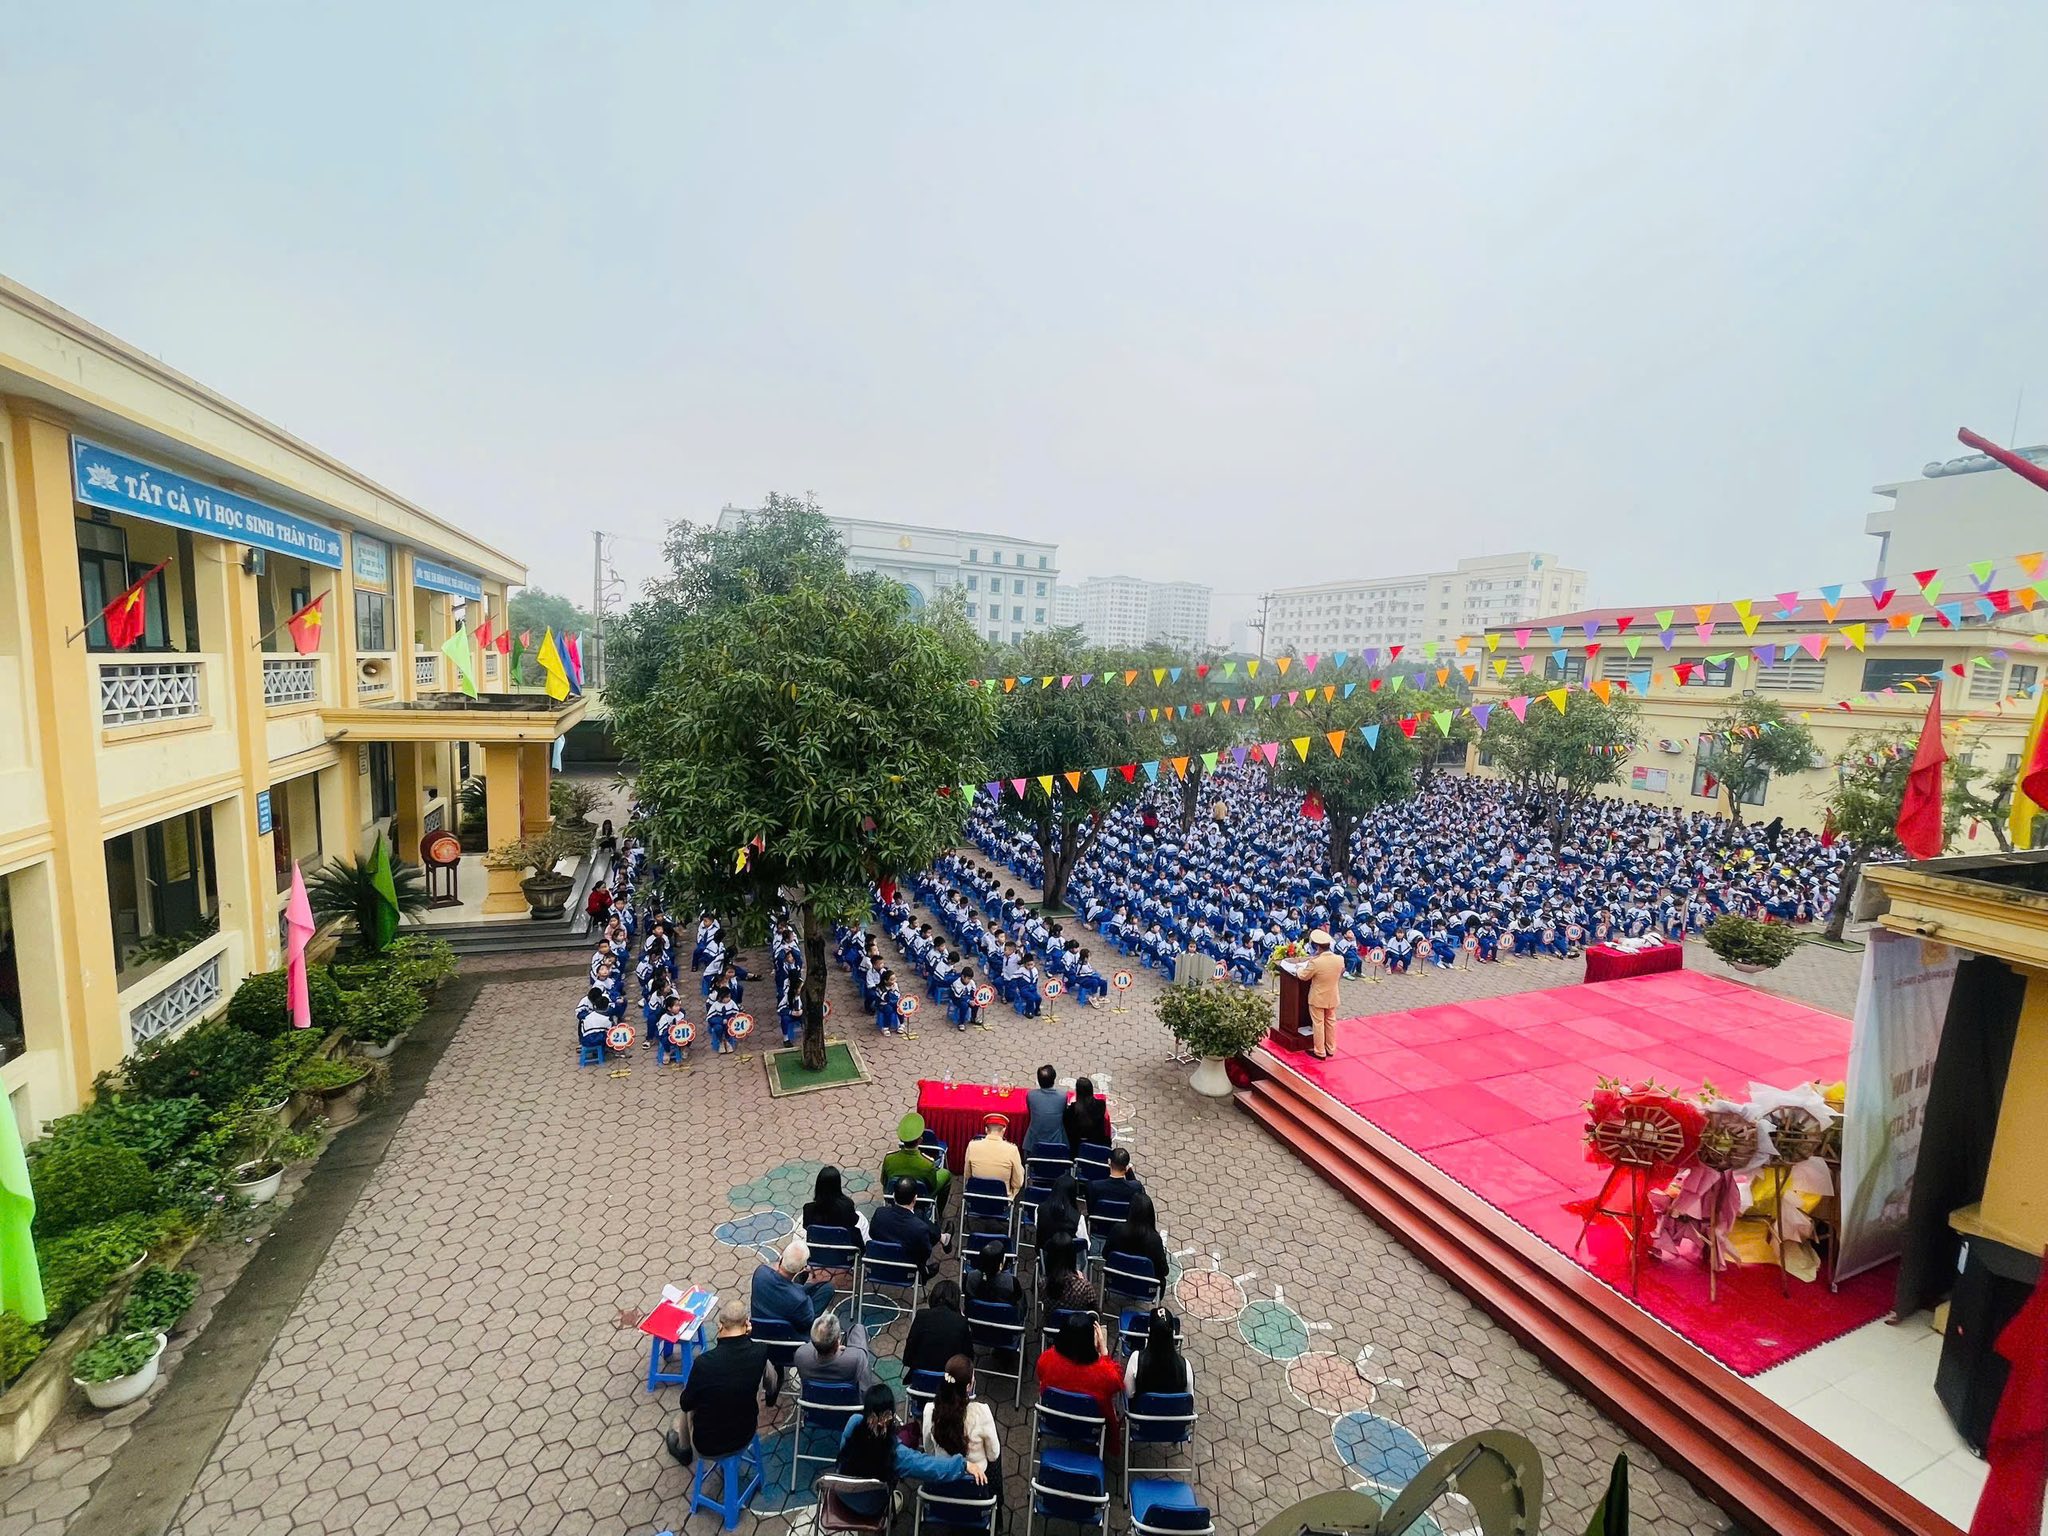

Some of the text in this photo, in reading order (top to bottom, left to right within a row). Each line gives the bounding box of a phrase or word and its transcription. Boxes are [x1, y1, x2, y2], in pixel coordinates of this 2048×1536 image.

[124, 471, 326, 554] TẤT CẢ VÌ HỌC SINH THÂN YÊU
[1117, 975, 1128, 985] 1A
[734, 1019, 748, 1031] 2C
[612, 1031, 628, 1043] 2A
[674, 1027, 690, 1039] 2B
